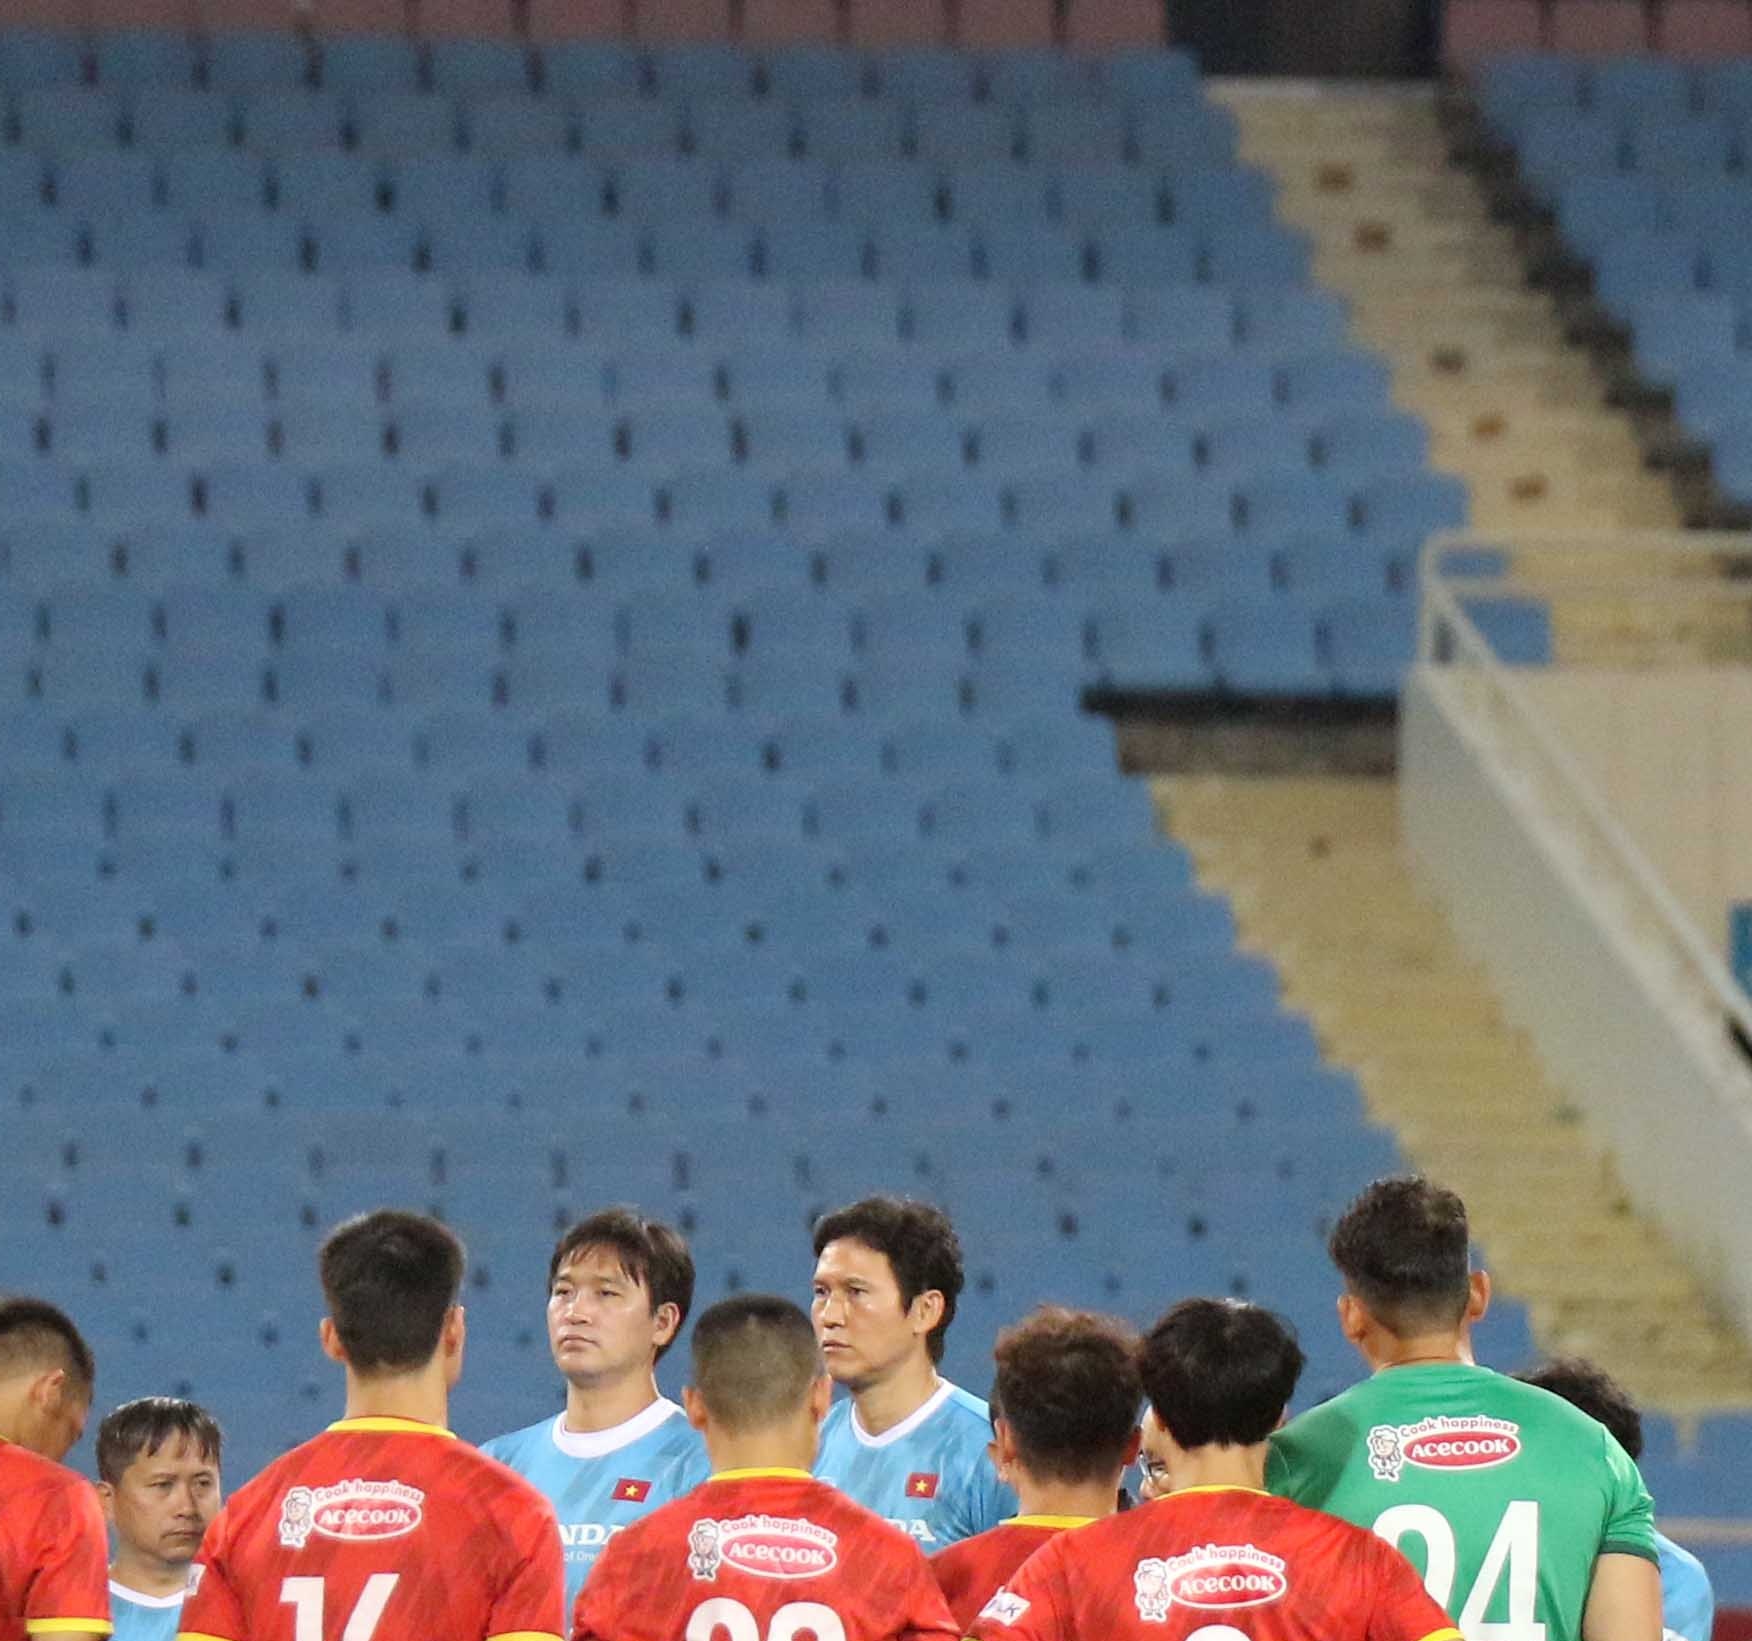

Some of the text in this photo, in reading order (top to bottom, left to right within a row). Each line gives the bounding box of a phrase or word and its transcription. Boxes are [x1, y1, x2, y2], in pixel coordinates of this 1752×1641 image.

[1401, 1416, 1517, 1438] Cook happiness
[314, 1480, 422, 1502] Cook happiness
[721, 1515, 835, 1545] Cook happiness
[1209, 1546, 1283, 1571] happiness
